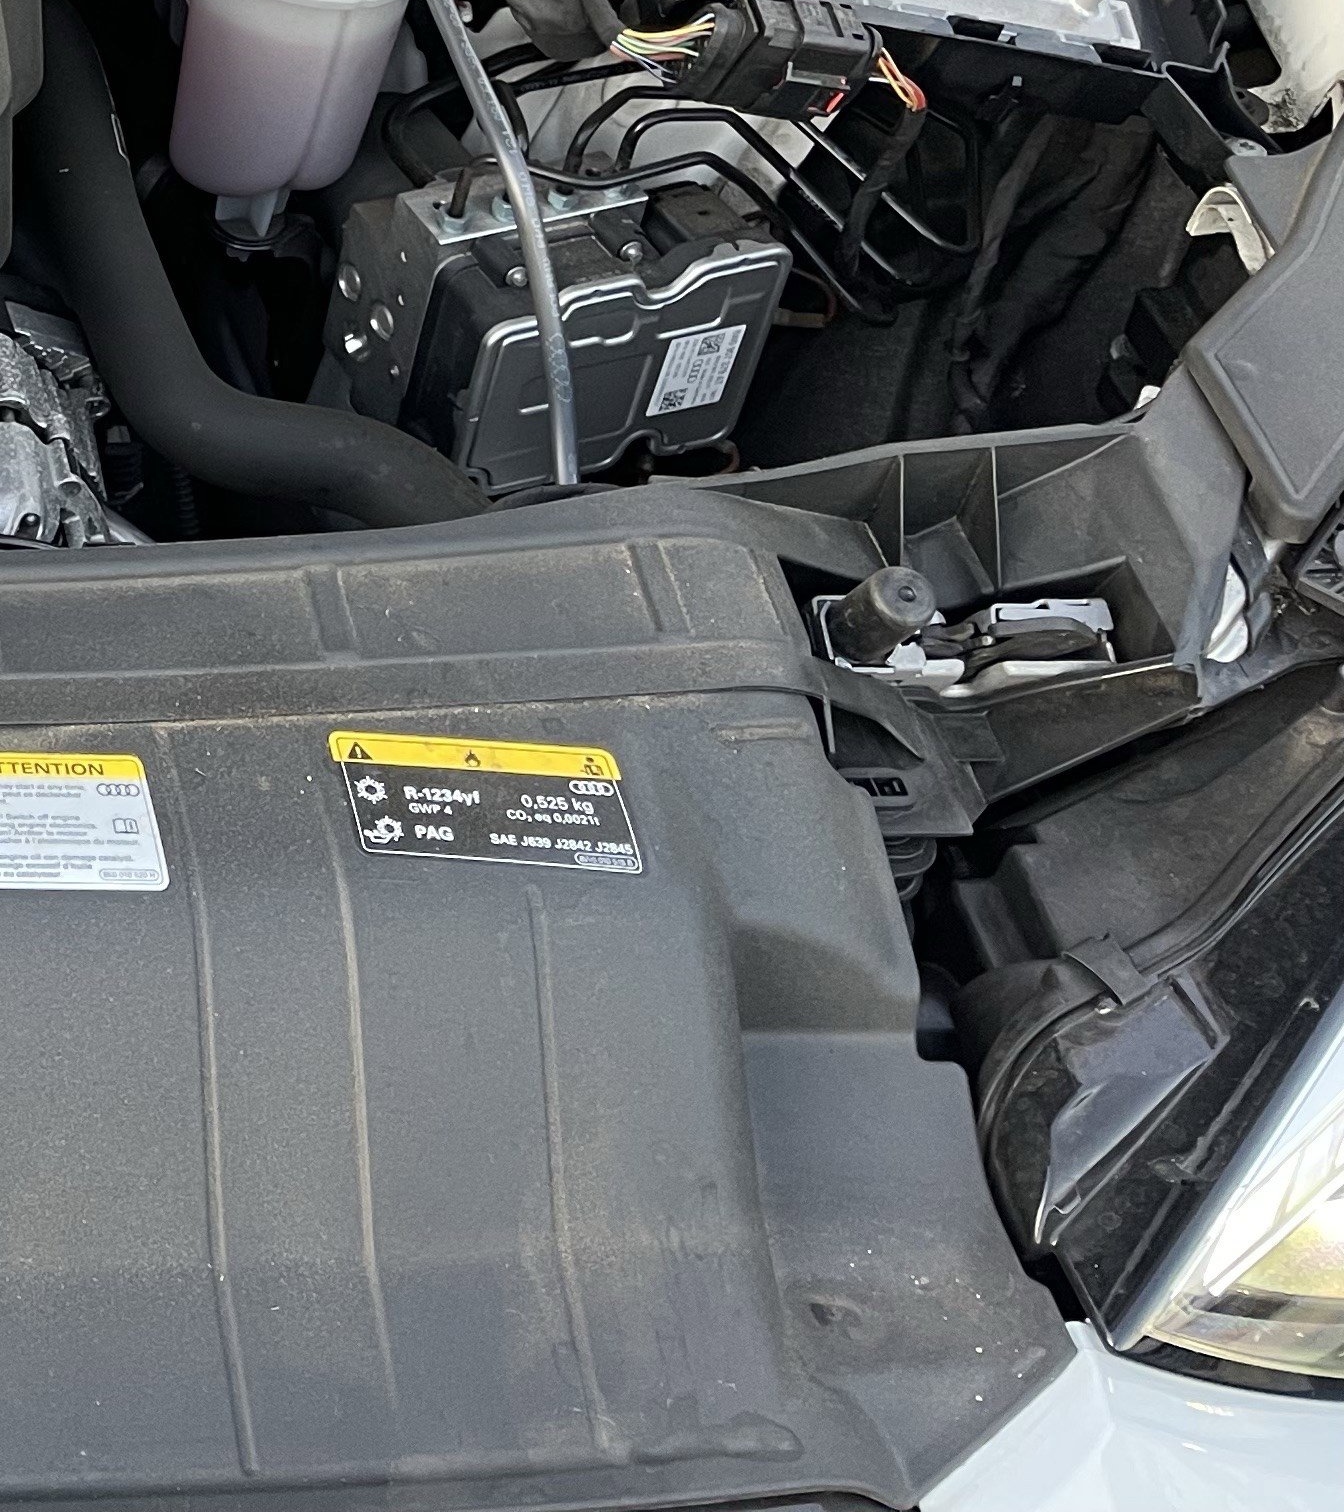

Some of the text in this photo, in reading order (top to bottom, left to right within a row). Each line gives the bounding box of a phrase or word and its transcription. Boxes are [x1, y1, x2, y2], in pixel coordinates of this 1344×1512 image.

[403, 785, 595, 815] R-1234yf 0,525 kg
[408, 802, 441, 814] GWP
[443, 805, 453, 815] 4
[533, 813, 553, 824] eq
[414, 824, 455, 842] PAG
[489, 832, 518, 846] SAE
[520, 835, 552, 848] J639
